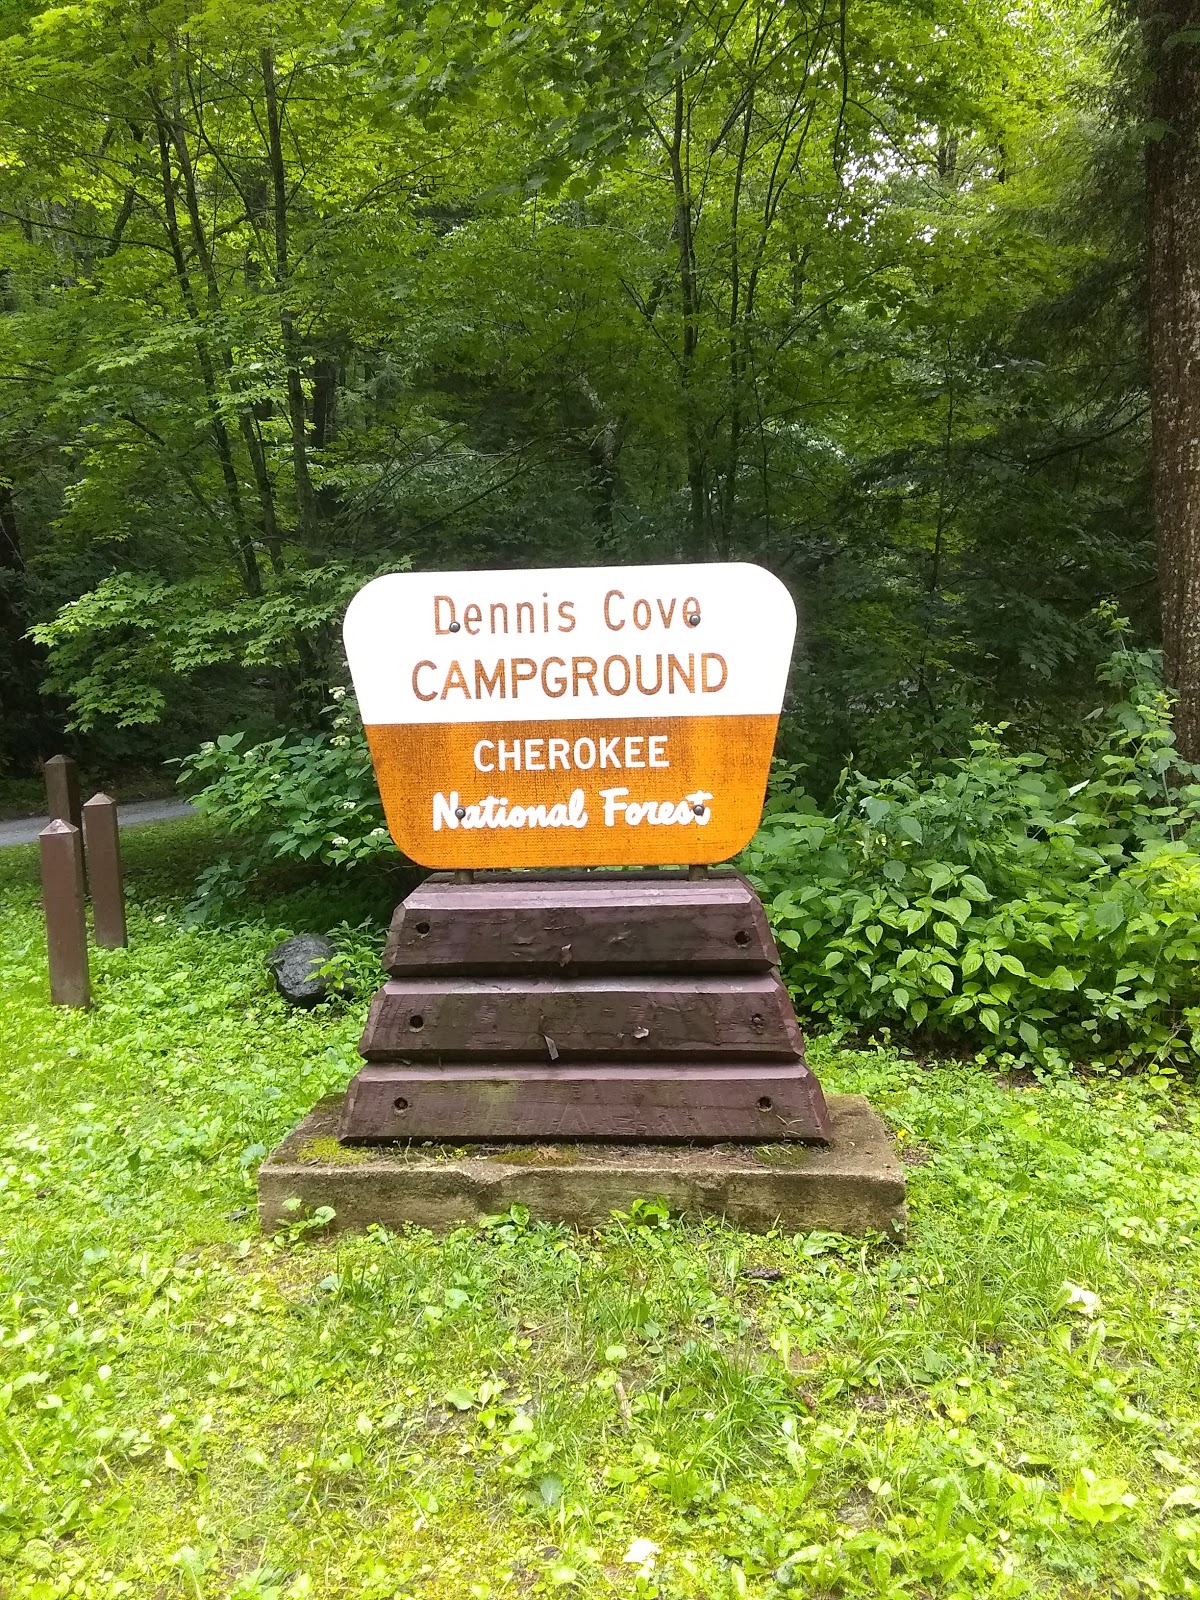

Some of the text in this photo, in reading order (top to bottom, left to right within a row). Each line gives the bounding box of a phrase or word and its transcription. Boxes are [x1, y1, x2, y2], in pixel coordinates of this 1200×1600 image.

[433, 589, 702, 636] Dennis Cove
[411, 652, 729, 702] CAMPGROUND
[473, 735, 670, 772] CHEROKEE
[432, 787, 714, 831] National Forest
